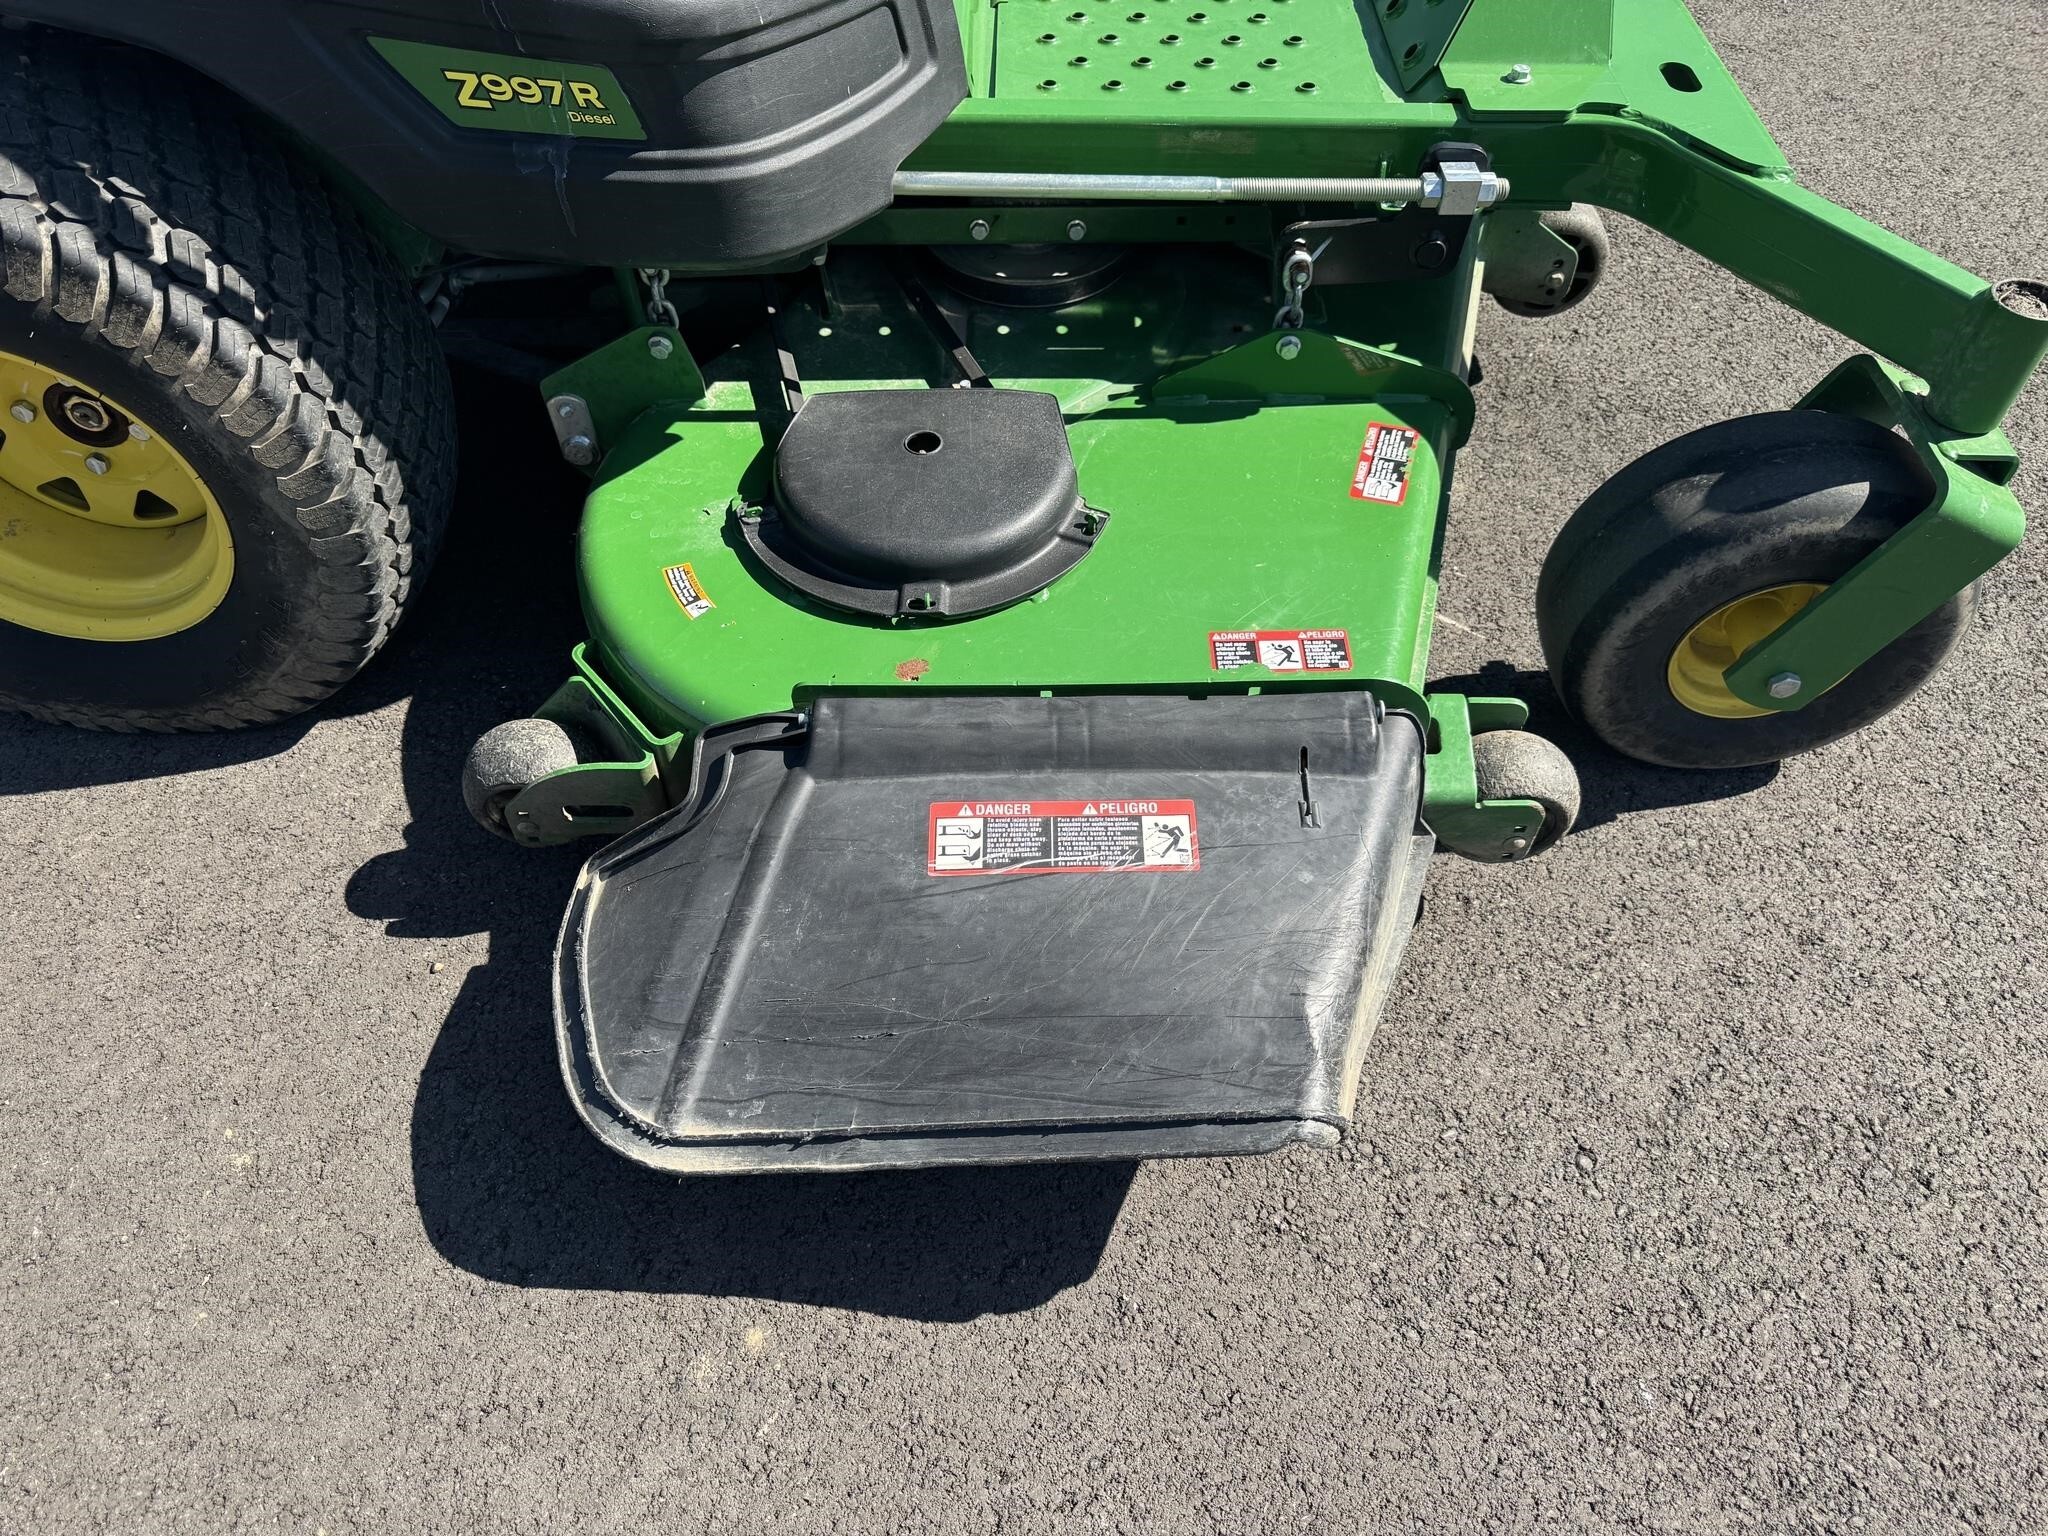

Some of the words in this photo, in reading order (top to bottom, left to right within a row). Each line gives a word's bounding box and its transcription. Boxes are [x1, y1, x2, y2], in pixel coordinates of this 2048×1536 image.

[568, 111, 616, 125] Diesel
[1355, 461, 1368, 483] DANGER
[1220, 632, 1256, 640] DANGER
[1306, 630, 1344, 639] PELIGRO
[976, 804, 1031, 815] DANGER
[1100, 802, 1158, 814] PELIGRO
